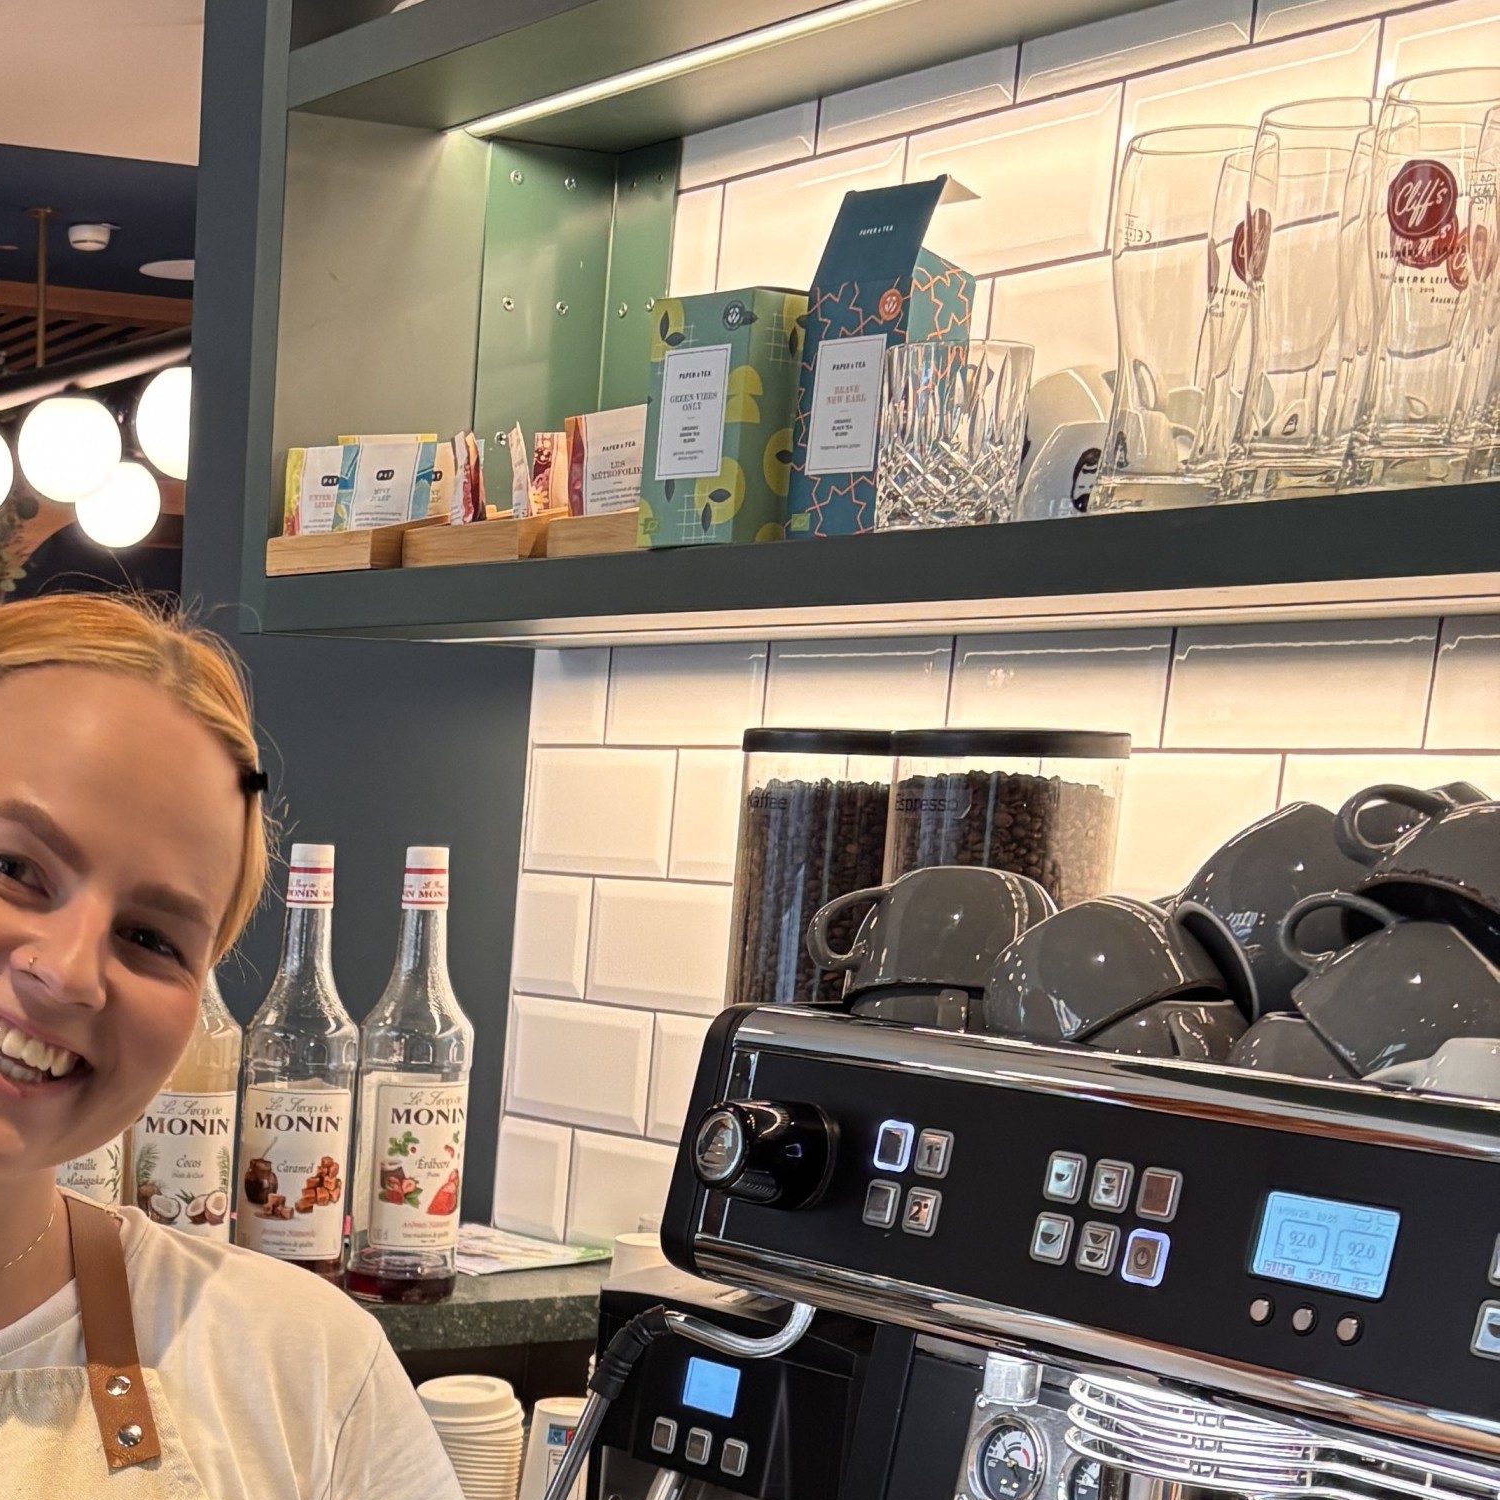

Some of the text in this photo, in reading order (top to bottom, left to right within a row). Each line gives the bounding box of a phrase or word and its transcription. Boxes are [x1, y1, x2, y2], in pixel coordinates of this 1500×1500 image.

[1394, 178, 1449, 228] Cliff's
[832, 362, 851, 371] PAPER
[855, 361, 866, 369] TEA
[679, 371, 696, 380] PAPER
[701, 369, 712, 377] TEA
[669, 392, 694, 404] GREEN
[682, 401, 702, 412] ONLY
[602, 442, 620, 453] PAPER
[625, 440, 637, 448] TEA
[747, 792, 789, 810] Kaffee
[895, 793, 959, 813] Espresso
[157, 1100, 223, 1119] Le Sirop de
[265, 1096, 284, 1111] Le
[285, 1097, 318, 1116] Sirop
[145, 1115, 229, 1136] MONIN
[255, 1112, 340, 1133] MONIN
[176, 1154, 201, 1168] Cocos
[276, 1160, 315, 1174] Caramel
